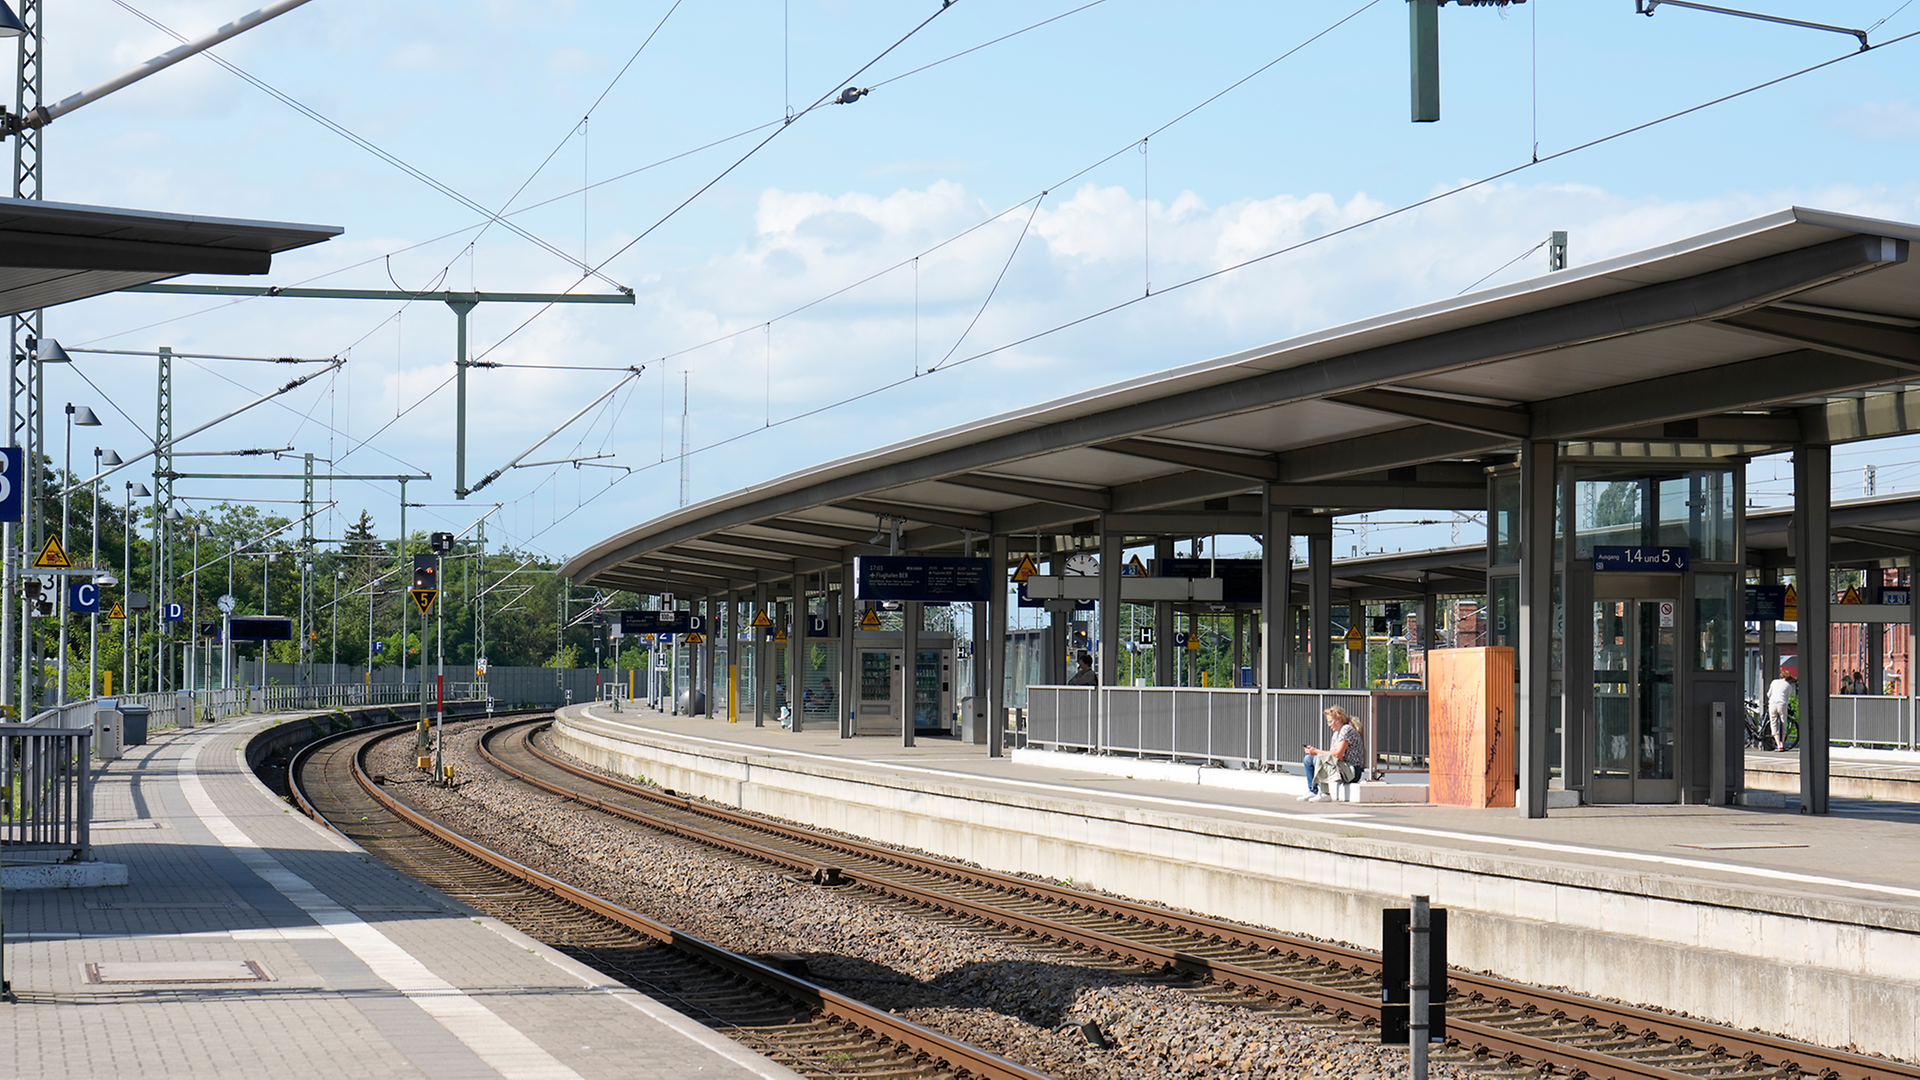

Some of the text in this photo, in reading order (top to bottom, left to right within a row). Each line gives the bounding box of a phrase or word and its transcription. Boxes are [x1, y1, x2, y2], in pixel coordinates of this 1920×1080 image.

[1644, 554, 1660, 563] und
[1661, 549, 1671, 563] 5
[78, 584, 96, 606] C
[421, 593, 428, 607] 5
[662, 594, 673, 611] H
[170, 604, 181, 619] D
[690, 616, 701, 630] D
[814, 618, 826, 631] D
[1141, 628, 1152, 642] H
[1175, 633, 1185, 644] C
[376, 641, 382, 650] F
[657, 653, 666, 666] H
